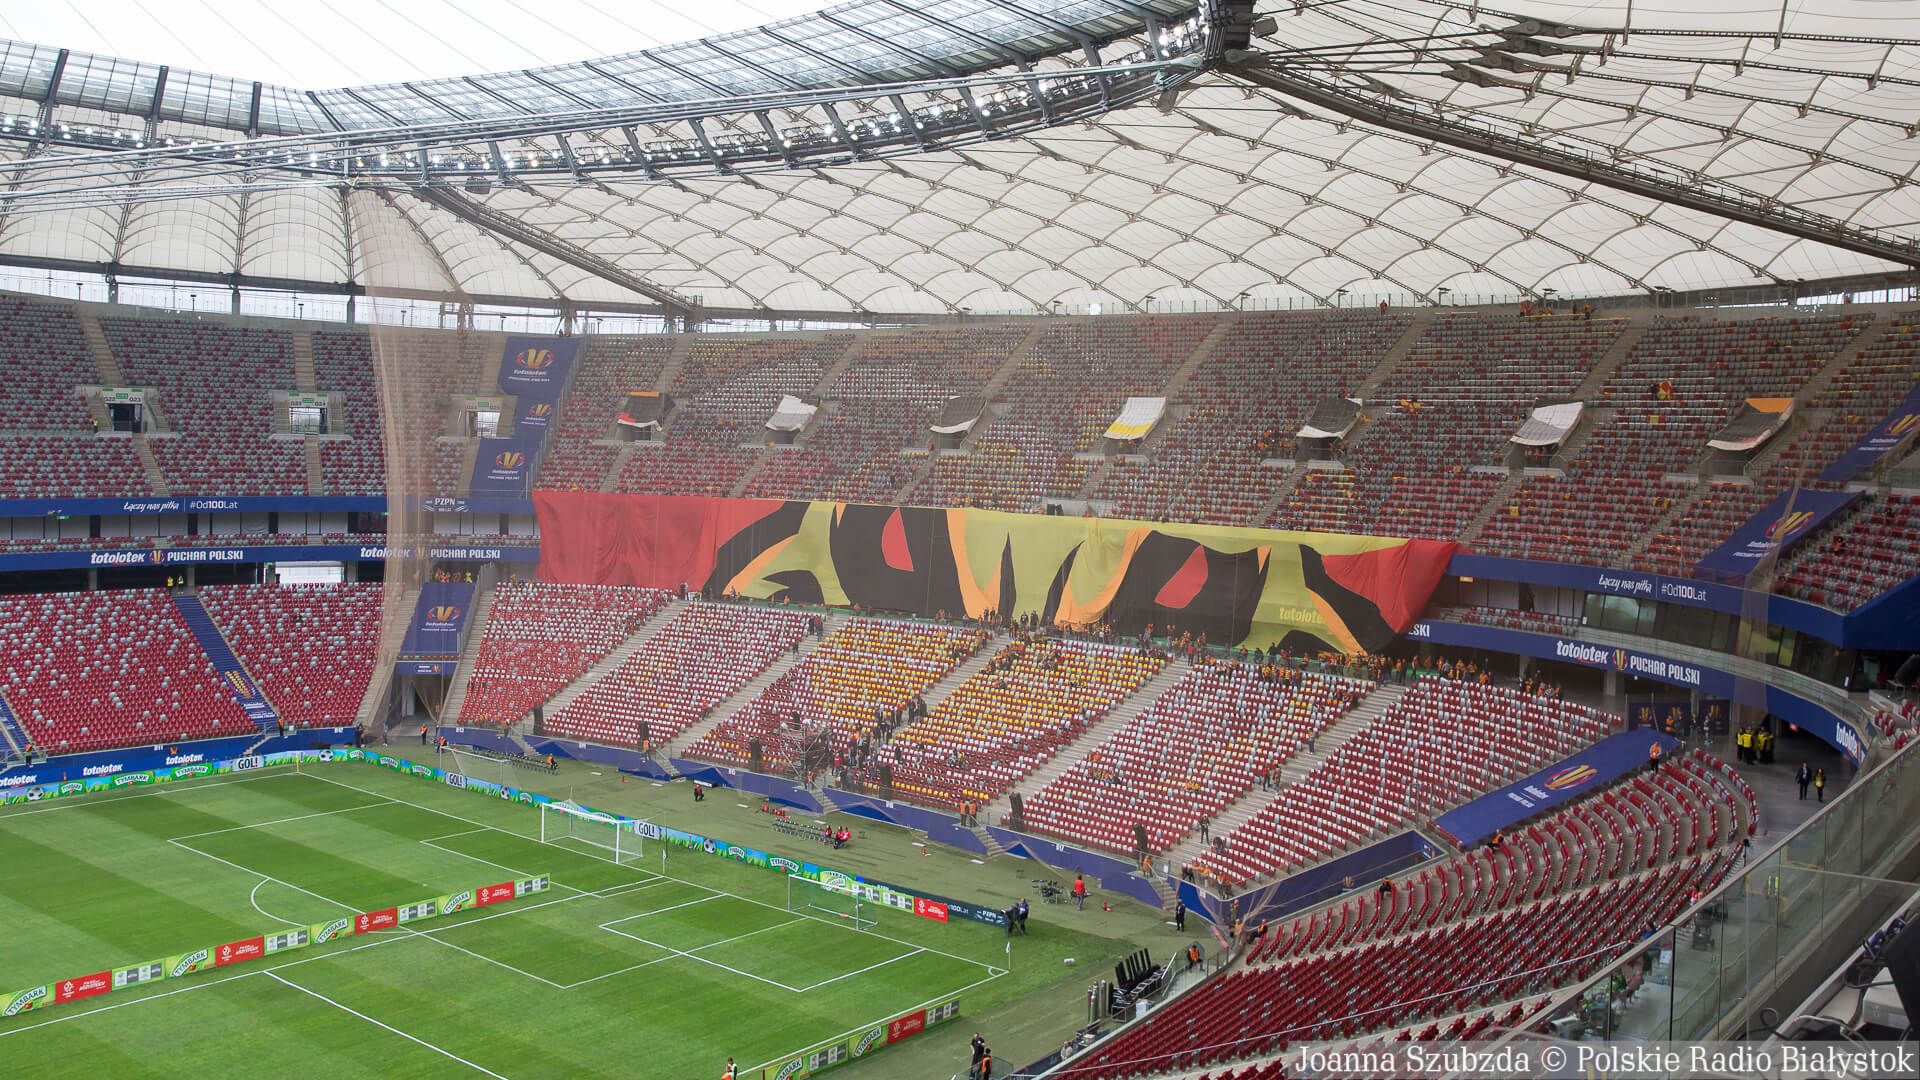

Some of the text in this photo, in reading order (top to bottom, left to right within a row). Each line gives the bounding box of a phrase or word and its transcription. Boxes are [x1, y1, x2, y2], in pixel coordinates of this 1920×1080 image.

[190, 500, 238, 509] #Od100Lat
[91, 551, 146, 565] totolotek
[167, 550, 244, 562] PUCHAR POLSKI
[430, 549, 501, 559] PUCHAR POLSKI
[1621, 580, 1635, 591] nas
[1660, 583, 1707, 602] #Od100Lat
[1279, 607, 1324, 625] totolote
[1556, 640, 1609, 665] totolotek
[1630, 655, 1701, 685] PUCHAR POLSKI
[166, 753, 203, 764] totolotek
[238, 757, 258, 770] GOL!
[83, 763, 123, 775] totolotek
[115, 774, 149, 786] TYMBARK
[449, 774, 462, 788] GOL!
[638, 822, 655, 837] GOL!
[770, 857, 799, 873] TYMBARK
[6, 986, 46, 1016] TYMBARK
